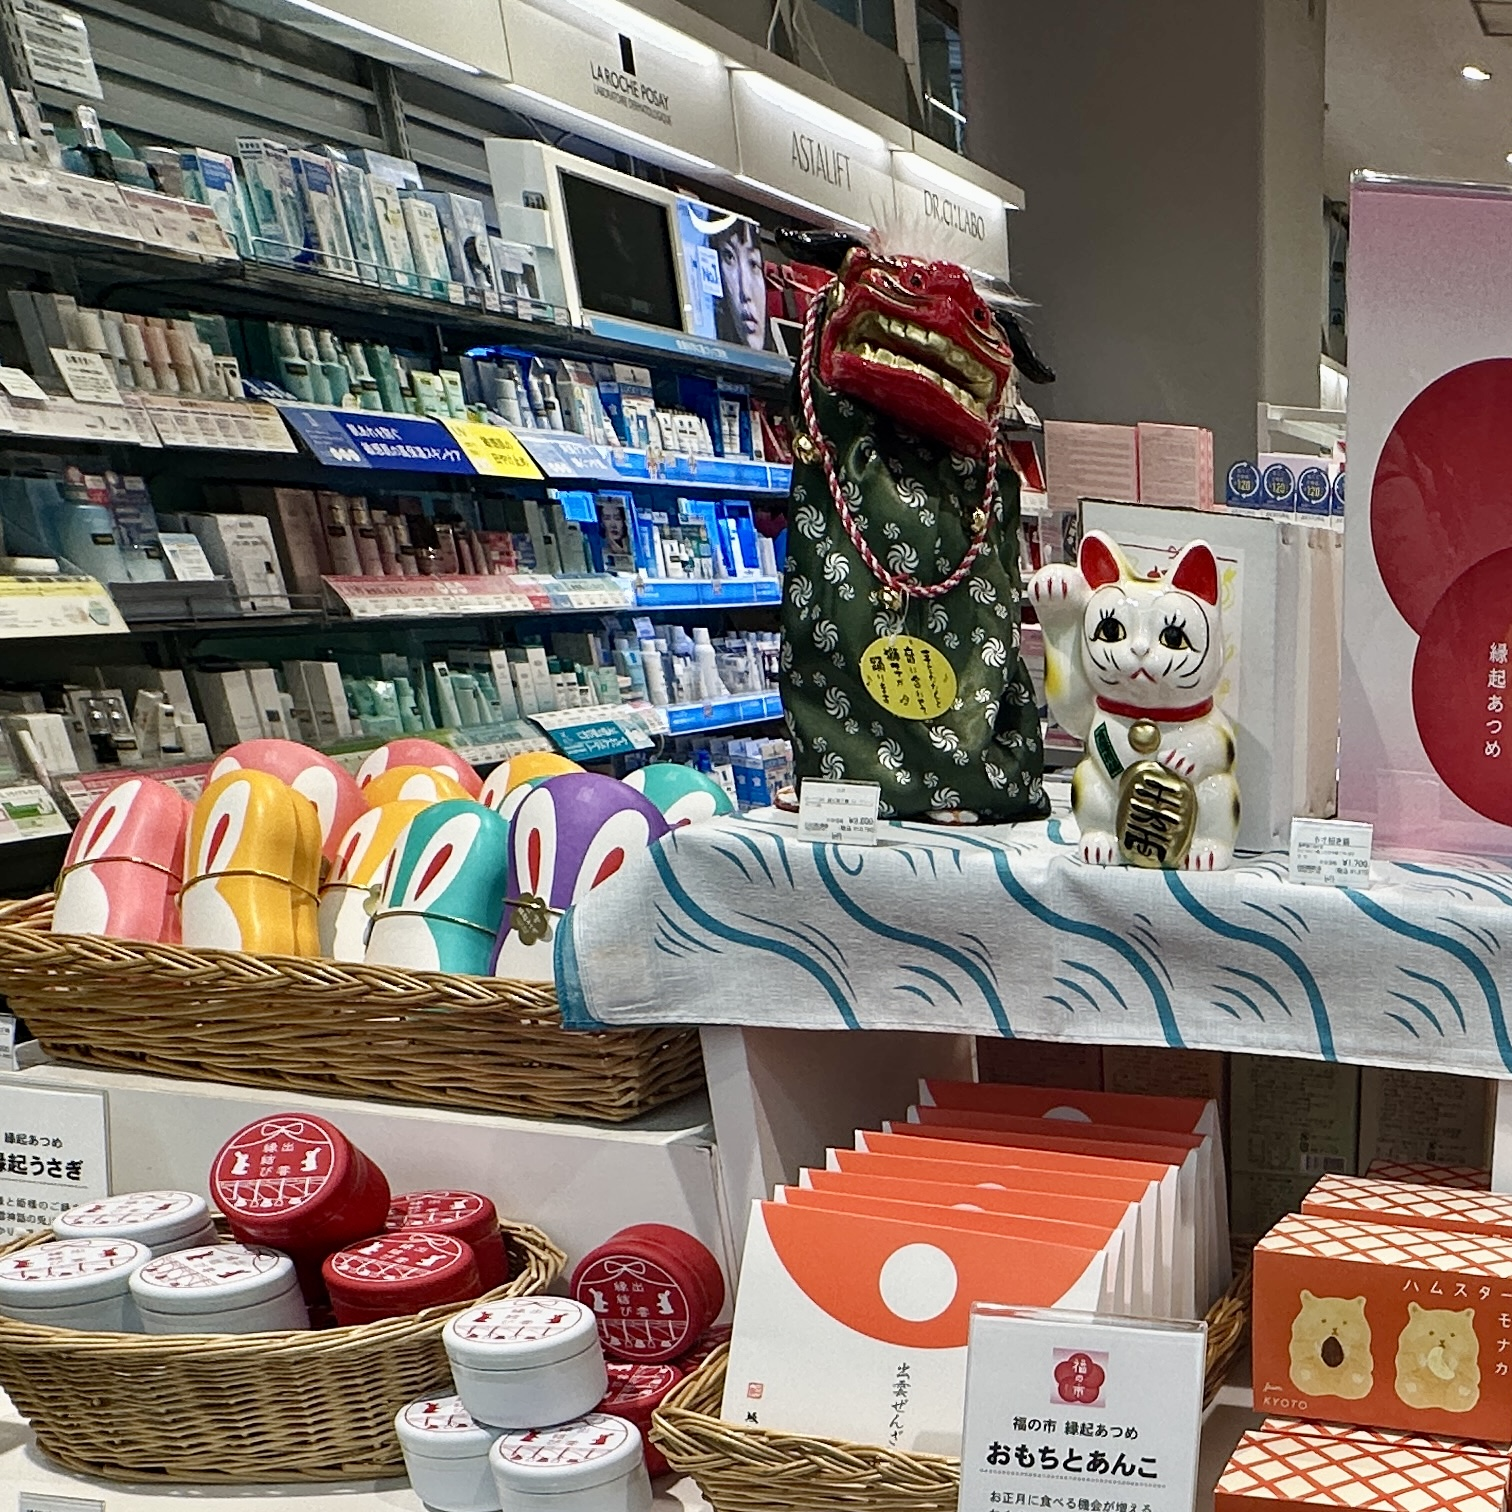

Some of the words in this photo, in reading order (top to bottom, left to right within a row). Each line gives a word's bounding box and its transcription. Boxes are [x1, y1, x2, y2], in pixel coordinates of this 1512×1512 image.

[791, 130, 851, 191] ASTALIFT
[1484, 642, 1509, 758] 縁起あつめ
[5, 1132, 63, 1149] 縁起あつめ
[0, 1152, 84, 1181] 起うさぎ
[1402, 1278, 1512, 1301] ハムスター
[1495, 1313, 1512, 1377] モナカ
[889, 1362, 911, 1447] 出雲ぜんざ
[1263, 1396, 1308, 1411] KYOTO
[1013, 1416, 1057, 1433] 福の市
[1064, 1420, 1138, 1440] 縁起あつめ
[986, 1440, 1158, 1479] おもちとあんこ
